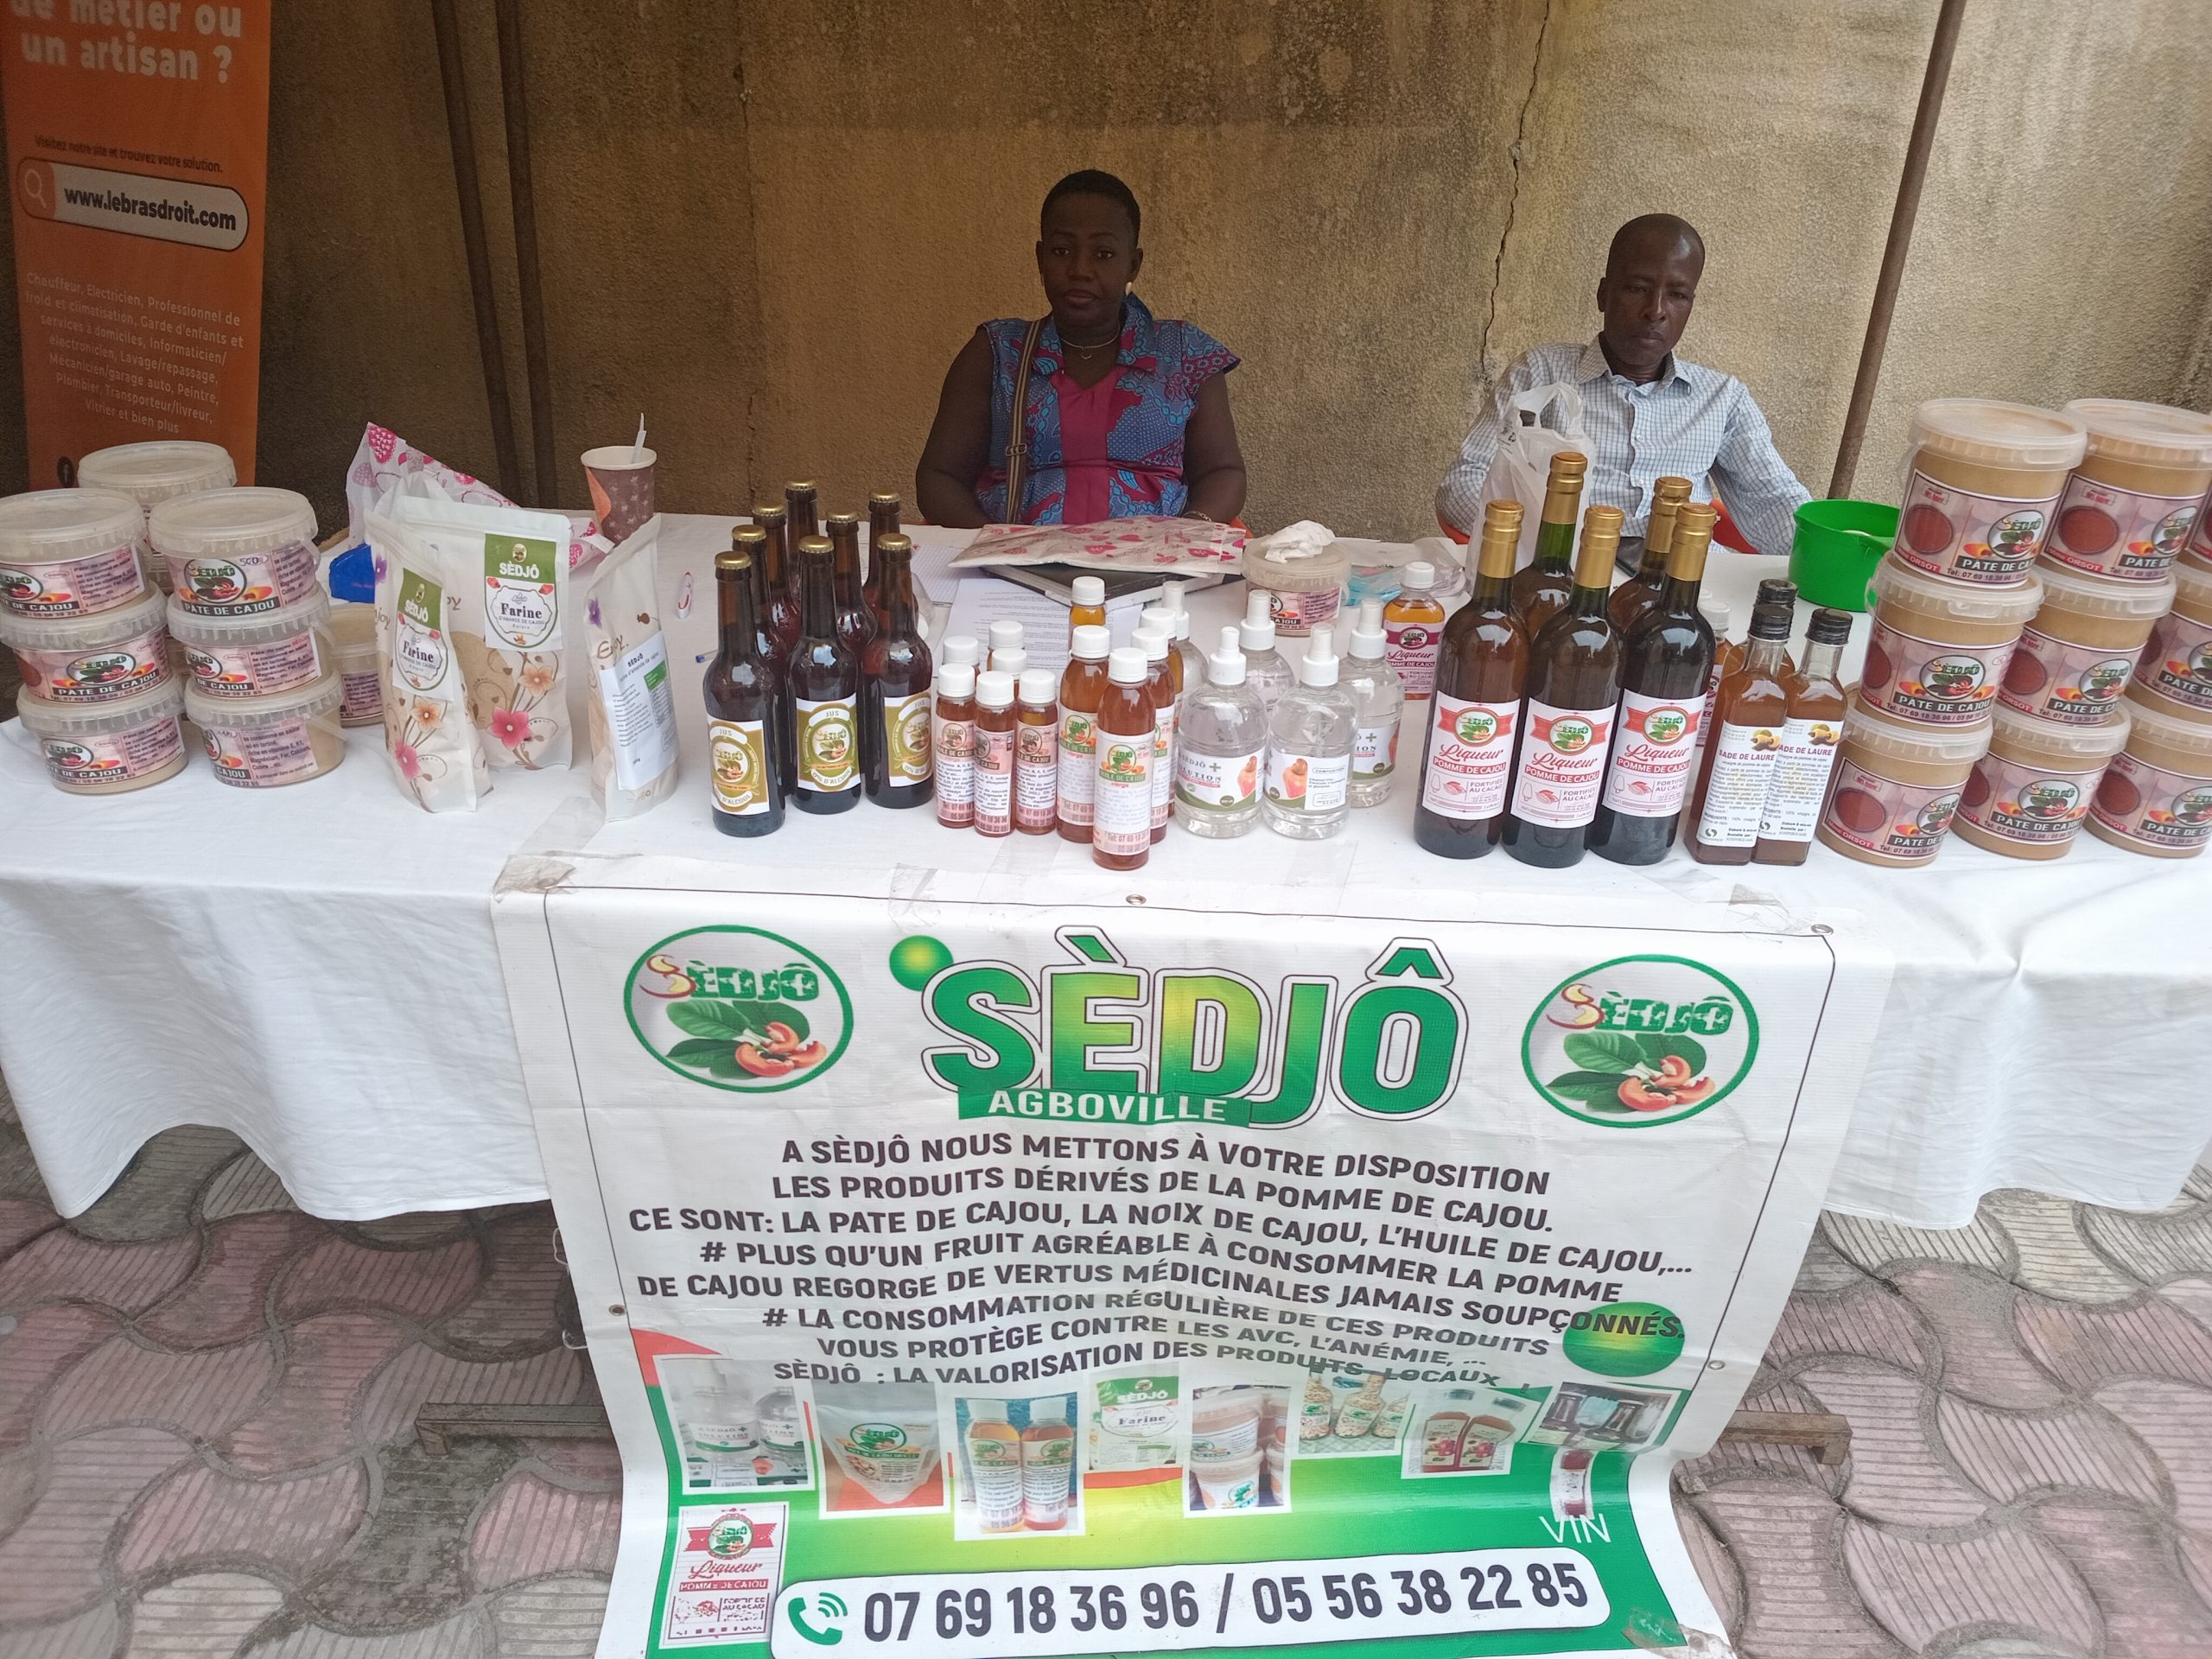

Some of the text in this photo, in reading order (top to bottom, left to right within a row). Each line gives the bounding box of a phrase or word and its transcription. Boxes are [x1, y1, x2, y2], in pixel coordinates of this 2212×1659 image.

[194, 3, 242, 38] ou
[22, 30, 232, 84] un artisan ?
[35, 135, 223, 173] Visitez notre site et trouvez votre solution.
[64, 188, 237, 231] www.lebrasdroit.com
[26, 272, 85, 295] Chauffeur,
[148, 296, 222, 323] Professionnel
[225, 311, 241, 327] de
[25, 290, 245, 348] froid et climatisation, Garde d'enfants et
[41, 314, 227, 367] services à domiciles, Informaticien/
[121, 352, 219, 385] Lavage/repassage,
[86, 397, 180, 435] Vitrier et bien plus
[499, 561, 539, 579] SÈDJÔ
[1910, 555, 1938, 571] ORSOT
[2067, 556, 2101, 572] ORSOT
[213, 607, 229, 615] DE
[234, 600, 274, 614] CAJOU
[501, 602, 543, 619] Farine
[403, 640, 434, 663] Farine
[1388, 651, 1434, 660] Liqueur
[1938, 703, 1954, 712] DE
[1958, 700, 1990, 712] CAJOU
[1434, 758, 1465, 772] POMME
[1480, 762, 1506, 774] CAJOU
[1440, 744, 1503, 761] Liqueur
[1532, 753, 1598, 770] Liqueur
[1618, 757, 1651, 773] POMME
[1668, 760, 1690, 772] CAJOU
[1624, 744, 1689, 761] Liqueur
[1808, 747, 1833, 756] LAURE
[1526, 766, 1599, 783] POMME DE CAJOU
[1843, 831, 1872, 847] ORSOT
[922, 925, 1467, 1128] SÈDJÔ
[987, 1090, 1226, 1122] AGBOVILLE
[782, 1132, 1550, 1194] A SÈDJÔ NOUS METTONS À VOTRE DISPOSITION
[772, 1165, 1553, 1232] LES PRODUITS DÉRIVÉS DE LA POMME DE CAJOU.
[629, 1208, 672, 1231] CE
[679, 1209, 773, 1233] SONT:
[782, 1211, 821, 1233] LA
[830, 1211, 906, 1234] PATE
[916, 1208, 956, 1232] DE
[966, 1200, 1071, 1228] CAJOU,
[1082, 1203, 1118, 1224] LA
[1128, 1202, 1204, 1226] NOIX
[1213, 1208, 1254, 1234] DE
[1262, 1217, 1369, 1247] CAJOU,
[1378, 1224, 1499, 1260] L'HUILE
[1507, 1241, 1551, 1265] DE
[700, 1230, 1624, 1303] # PLUS QU'UN FRUIT AGRÉABLE À CONSOMMER LA POMME
[638, 1258, 1686, 1338] DE CAJOU REGORGE DE VERTUS MÉDICINALES JAMAIS SOUPÇONNÉS.
[762, 1289, 1549, 1356] # LA CONSOMMATION RÉGULIÈRE DE CES PRODUITS
[817, 1338, 899, 1358] VOUS
[907, 1323, 1044, 1359] PROTÈGE
[1051, 1314, 1168, 1341] CONTRE
[1178, 1320, 1230, 1339] LES
[1236, 1328, 1300, 1348] AVC,
[1309, 1335, 1454, 1367] L'ANÉMIE,
[773, 1358, 861, 1384] SÈDJÔ
[893, 1367, 926, 1383] LA
[935, 1342, 1143, 1384] VALORISATION
[1153, 1341, 1208, 1360] DES
[1383, 1367, 1502, 1387] LOCAUX
[1539, 1513, 1611, 1543] VIN
[688, 1560, 763, 1579] Liqueur
[864, 1561, 1587, 1643] 07 69 18 36 96 / 05 56 38 22 85
